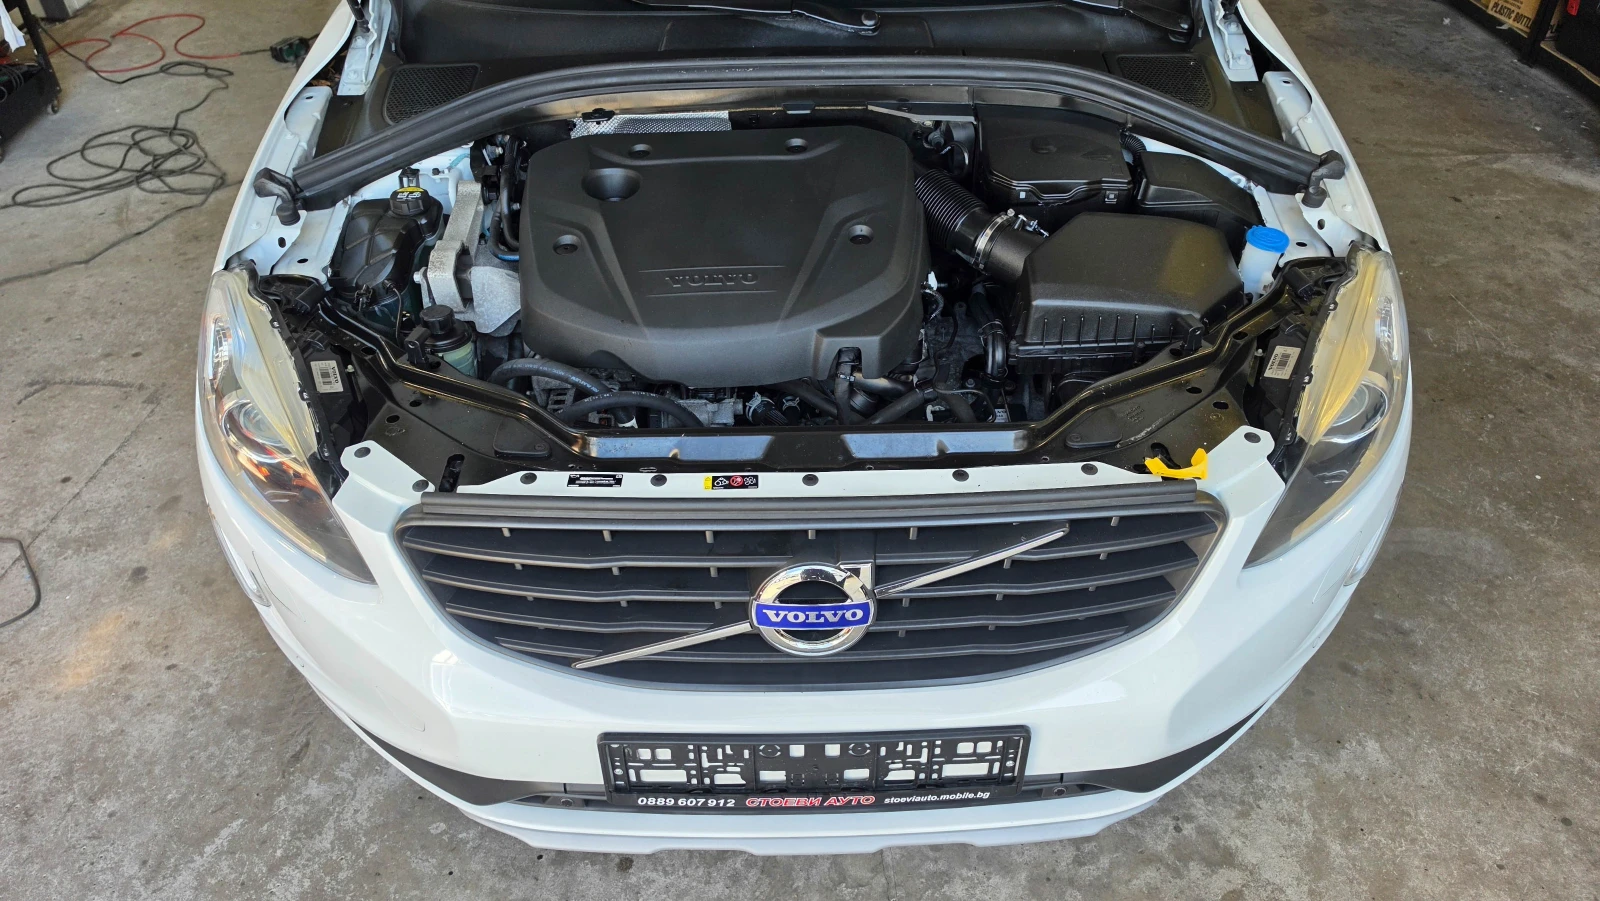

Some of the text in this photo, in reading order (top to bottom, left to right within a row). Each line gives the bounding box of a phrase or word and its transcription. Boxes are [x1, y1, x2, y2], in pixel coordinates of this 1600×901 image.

[1491, 2, 1515, 19] PLASTIC
[665, 274, 758, 287] VOLVO
[763, 609, 863, 623] VOLVO
[637, 795, 876, 807] 0889 607 912 СТОЕВИ АУТО
[884, 791, 990, 804] stoeviauto.mobile.bg
